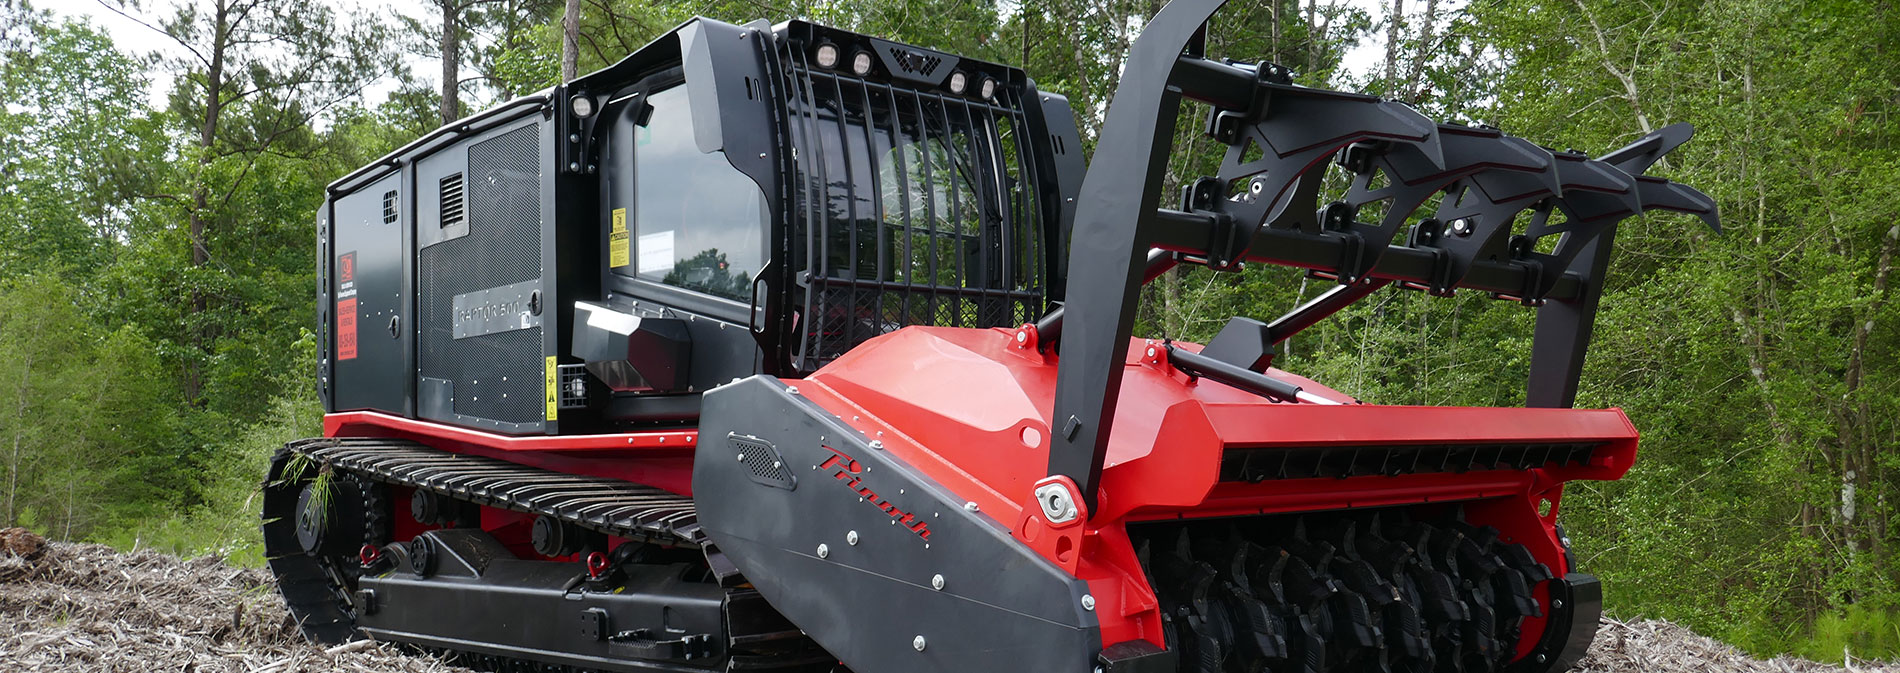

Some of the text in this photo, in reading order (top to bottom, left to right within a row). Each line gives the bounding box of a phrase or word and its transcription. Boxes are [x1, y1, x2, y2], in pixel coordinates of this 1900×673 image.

[458, 301, 519, 322] RAPTOR 500
[820, 445, 931, 541] Prinoth
